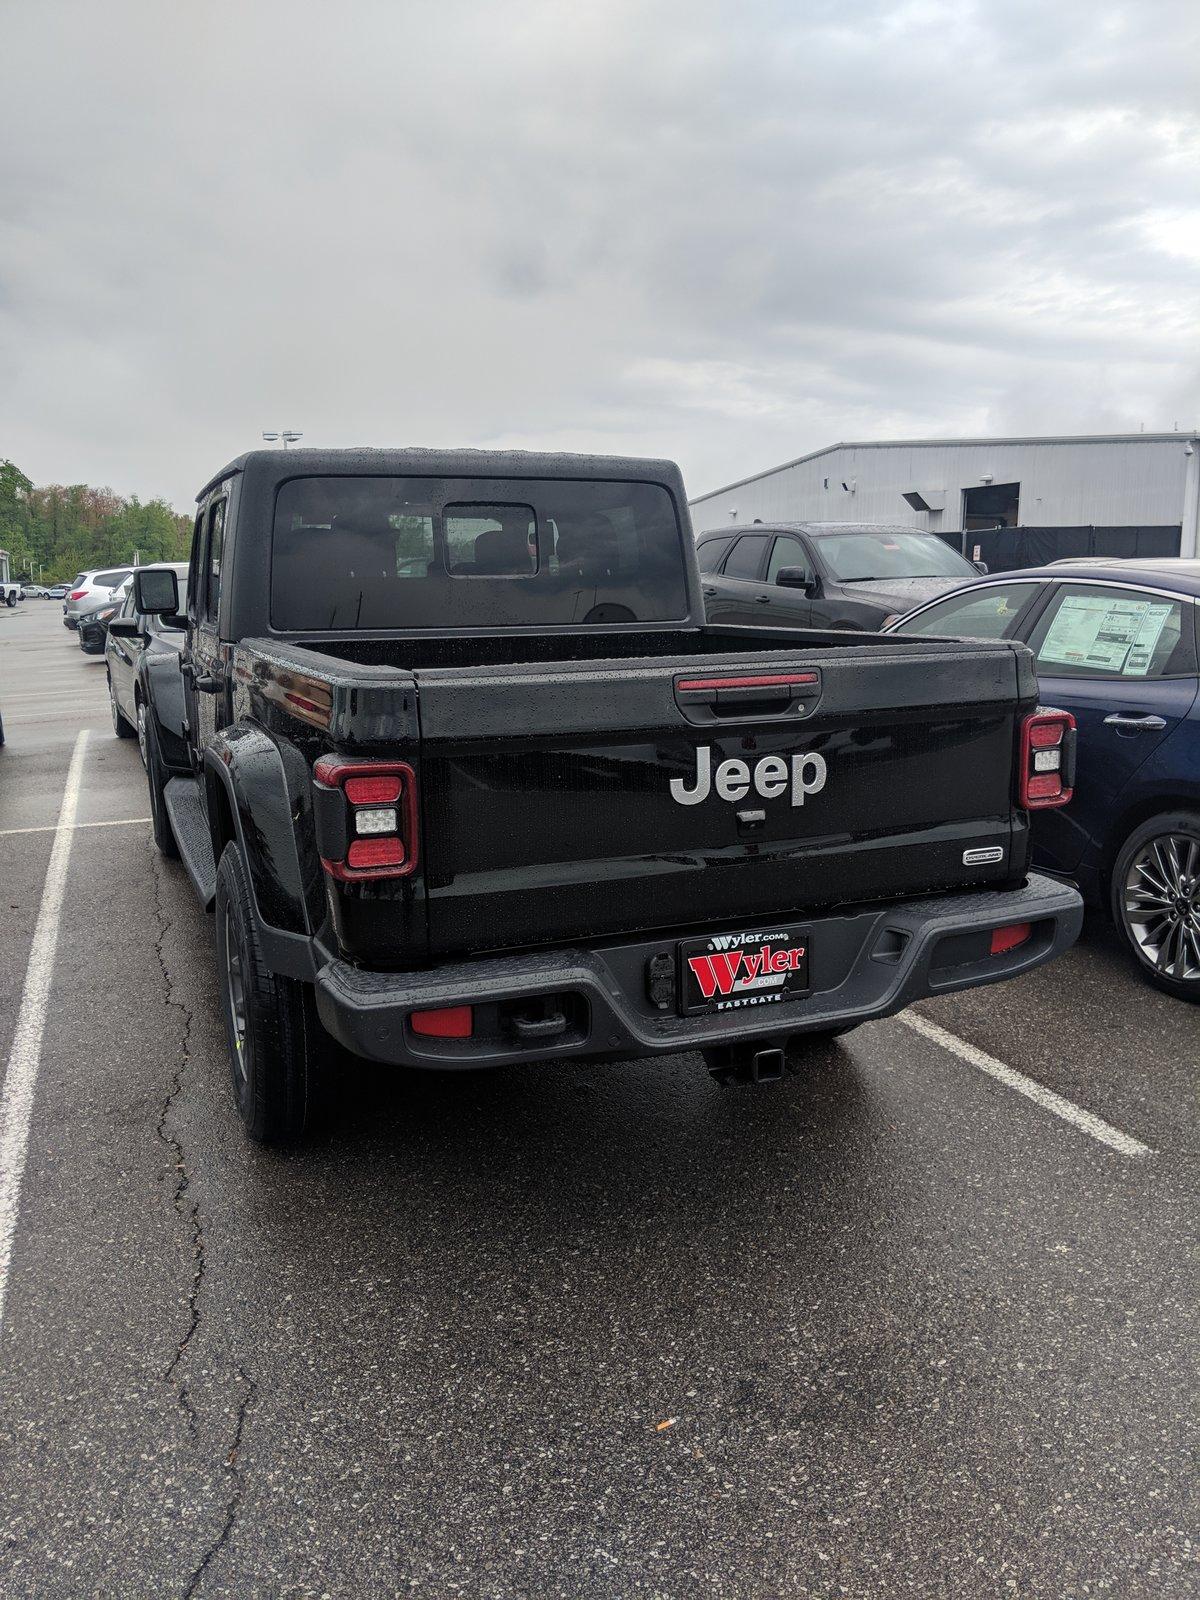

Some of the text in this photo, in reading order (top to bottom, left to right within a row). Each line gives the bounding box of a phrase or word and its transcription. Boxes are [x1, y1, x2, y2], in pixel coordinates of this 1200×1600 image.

[669, 746, 827, 807] Jeep
[689, 945, 805, 998] Wyler
[718, 995, 781, 1009] EASTGATE
